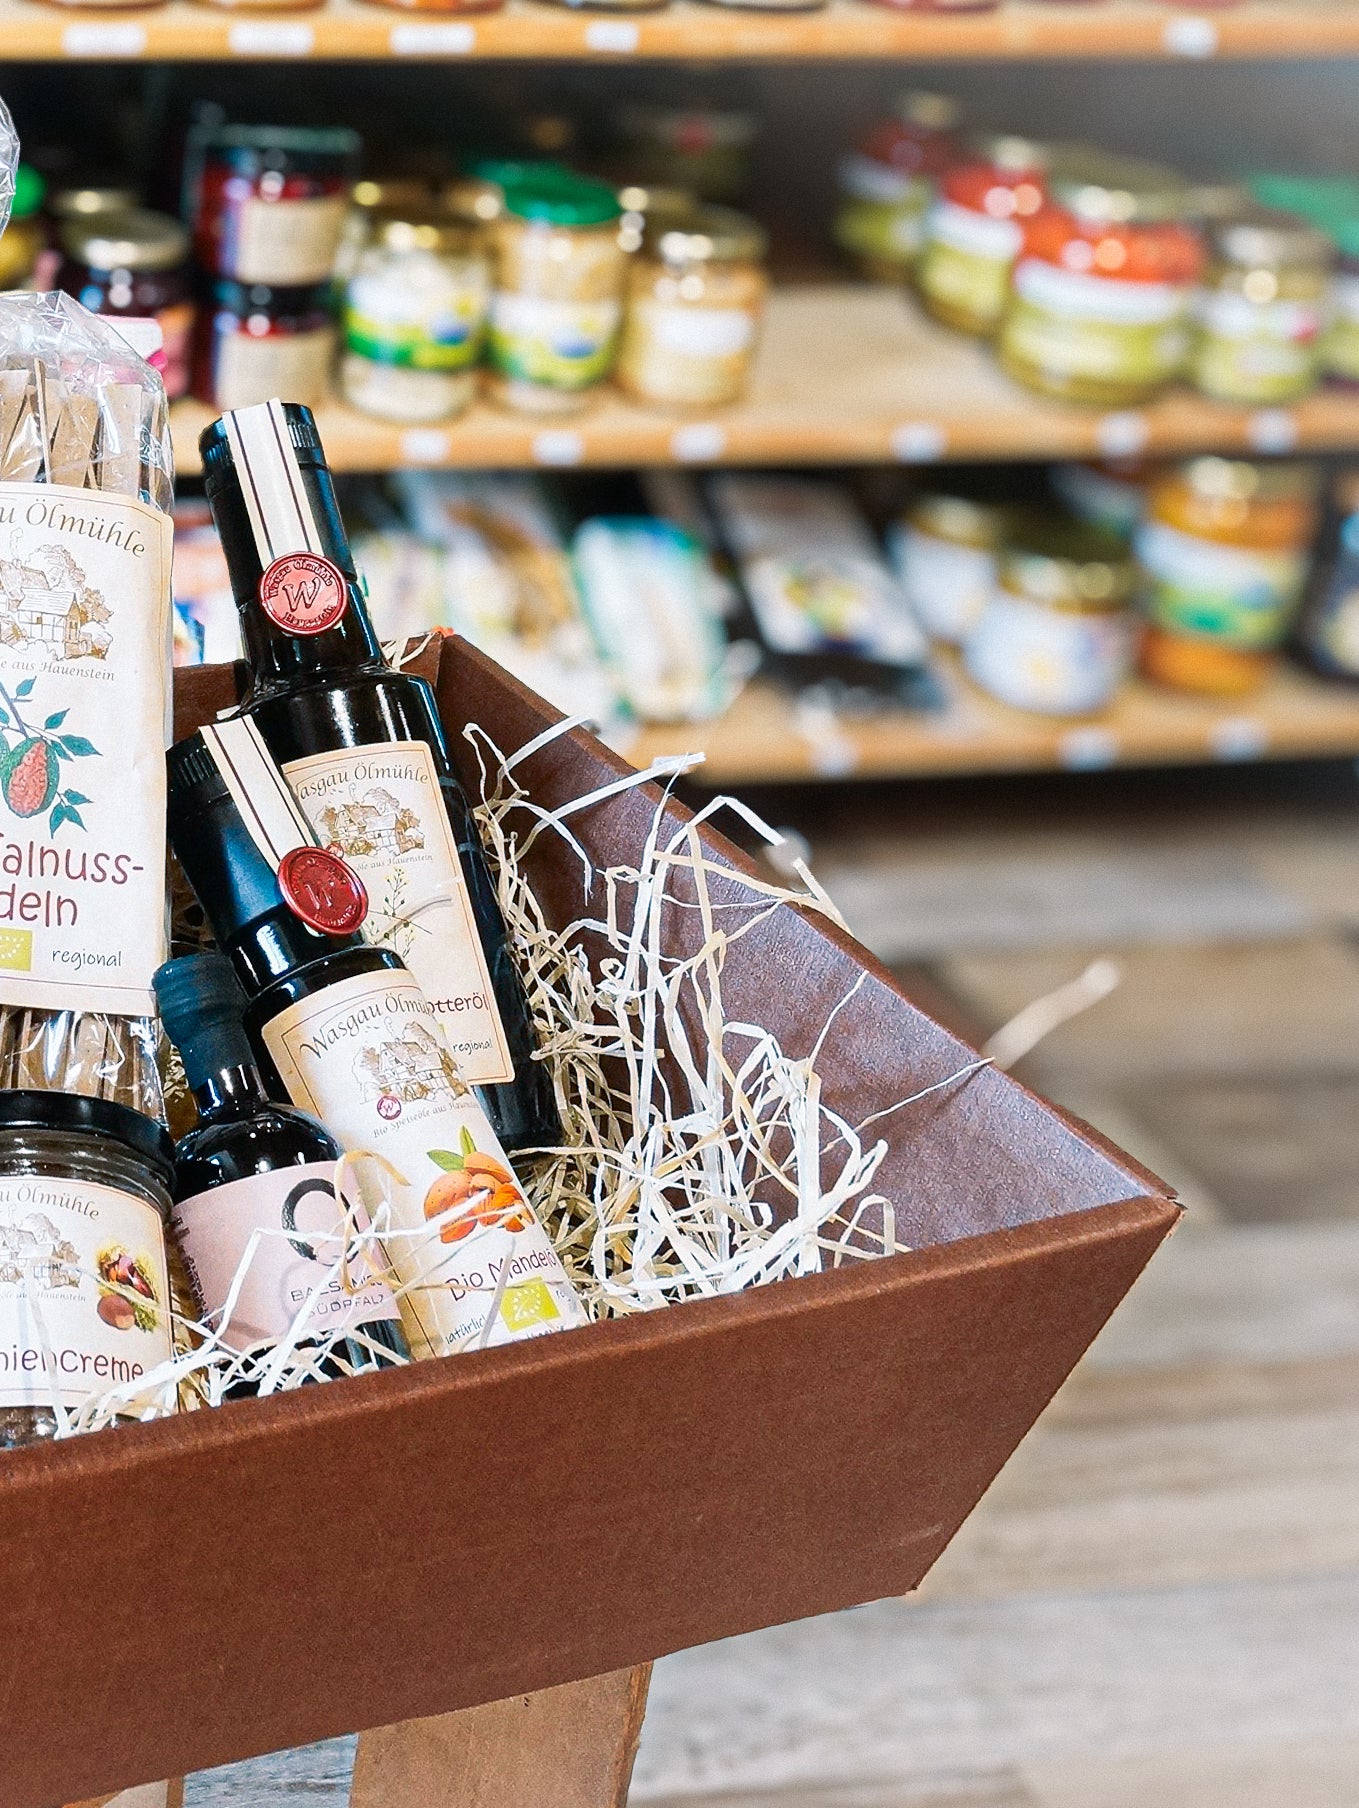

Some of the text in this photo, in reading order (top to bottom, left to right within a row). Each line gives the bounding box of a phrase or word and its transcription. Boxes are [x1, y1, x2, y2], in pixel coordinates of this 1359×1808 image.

[25, 498, 146, 558] Ölmühle
[281, 576, 322, 613] W
[11, 661, 36, 671] aus
[39, 662, 116, 681] Hauenstein
[300, 762, 430, 800] asgau Ölmühle
[51, 947, 122, 972] regional
[427, 992, 489, 1014] otteröl
[300, 1002, 382, 1060] Wasgau
[453, 1038, 494, 1056] regional
[17, 1184, 99, 1221] Ölmühle
[444, 1272, 484, 1302] Bio
